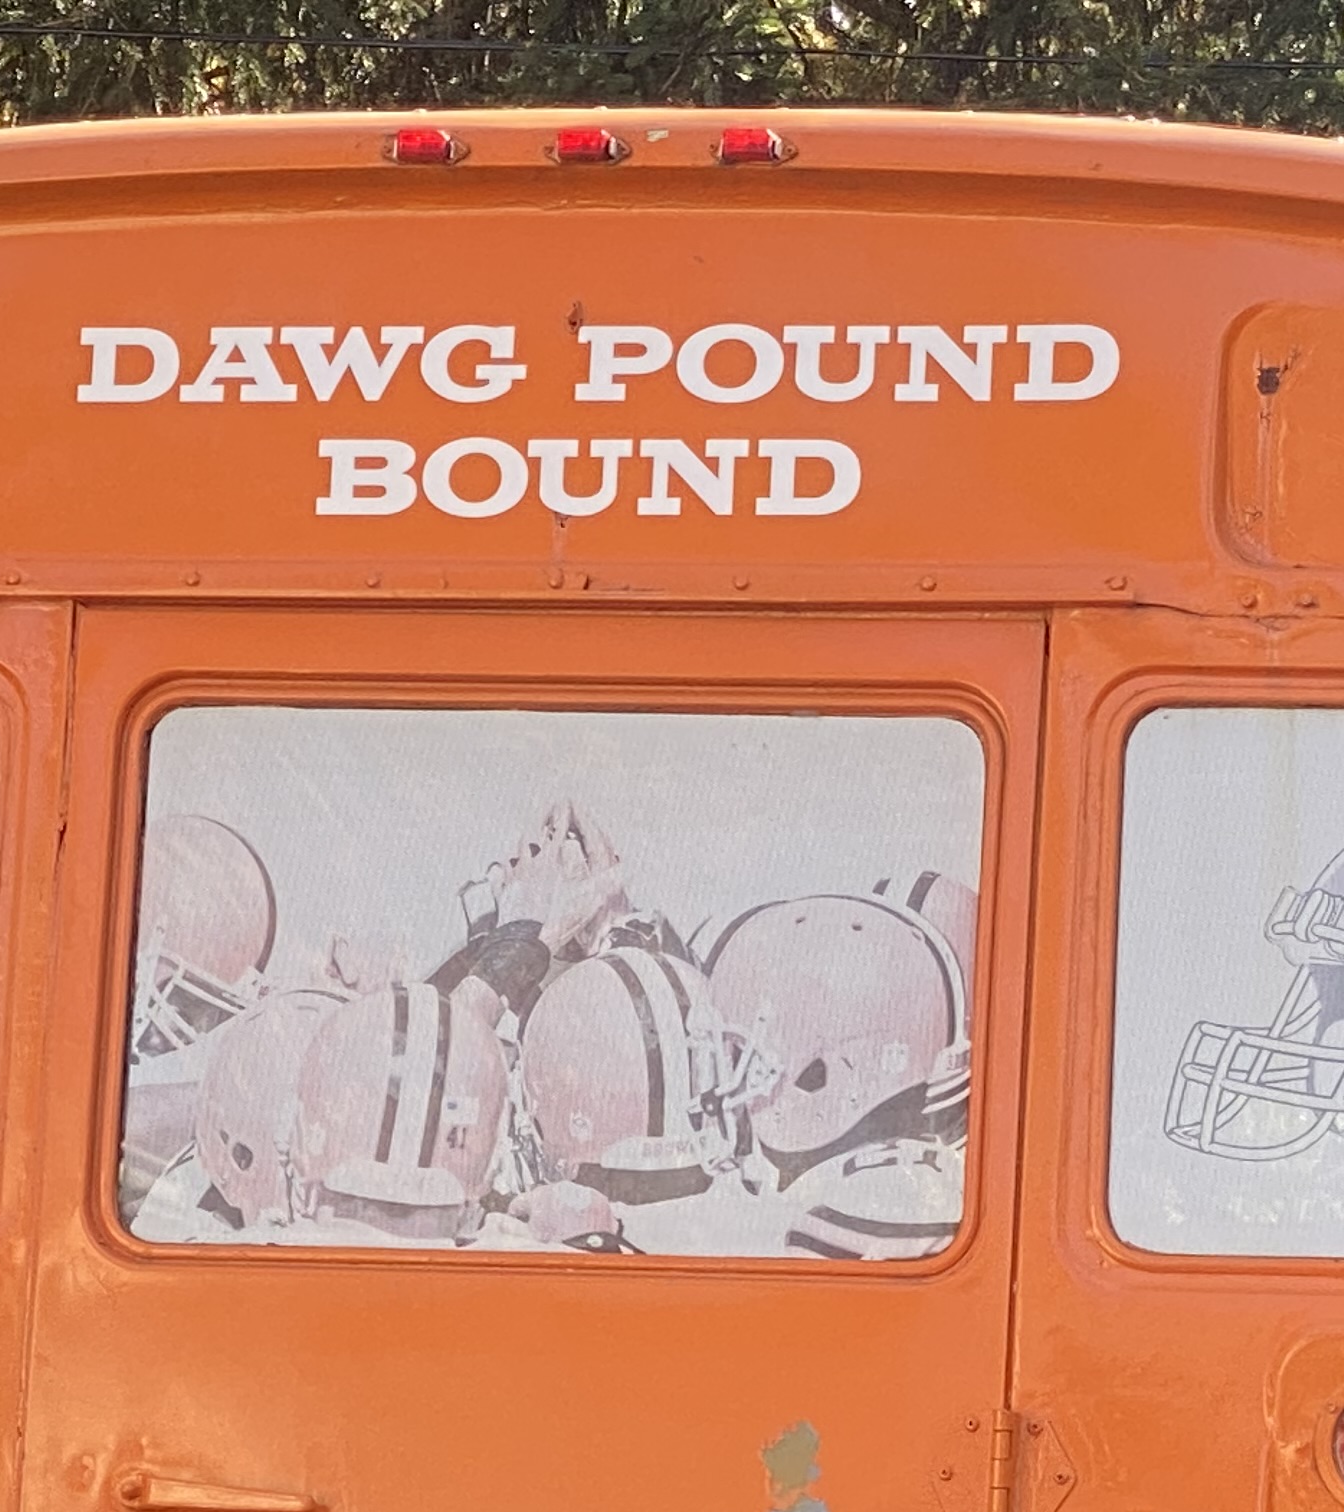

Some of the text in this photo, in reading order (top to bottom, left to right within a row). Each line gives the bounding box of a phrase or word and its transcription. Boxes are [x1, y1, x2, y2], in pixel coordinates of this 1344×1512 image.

[76, 323, 1121, 404] DAWG POUND
[315, 437, 861, 518] BOUND
